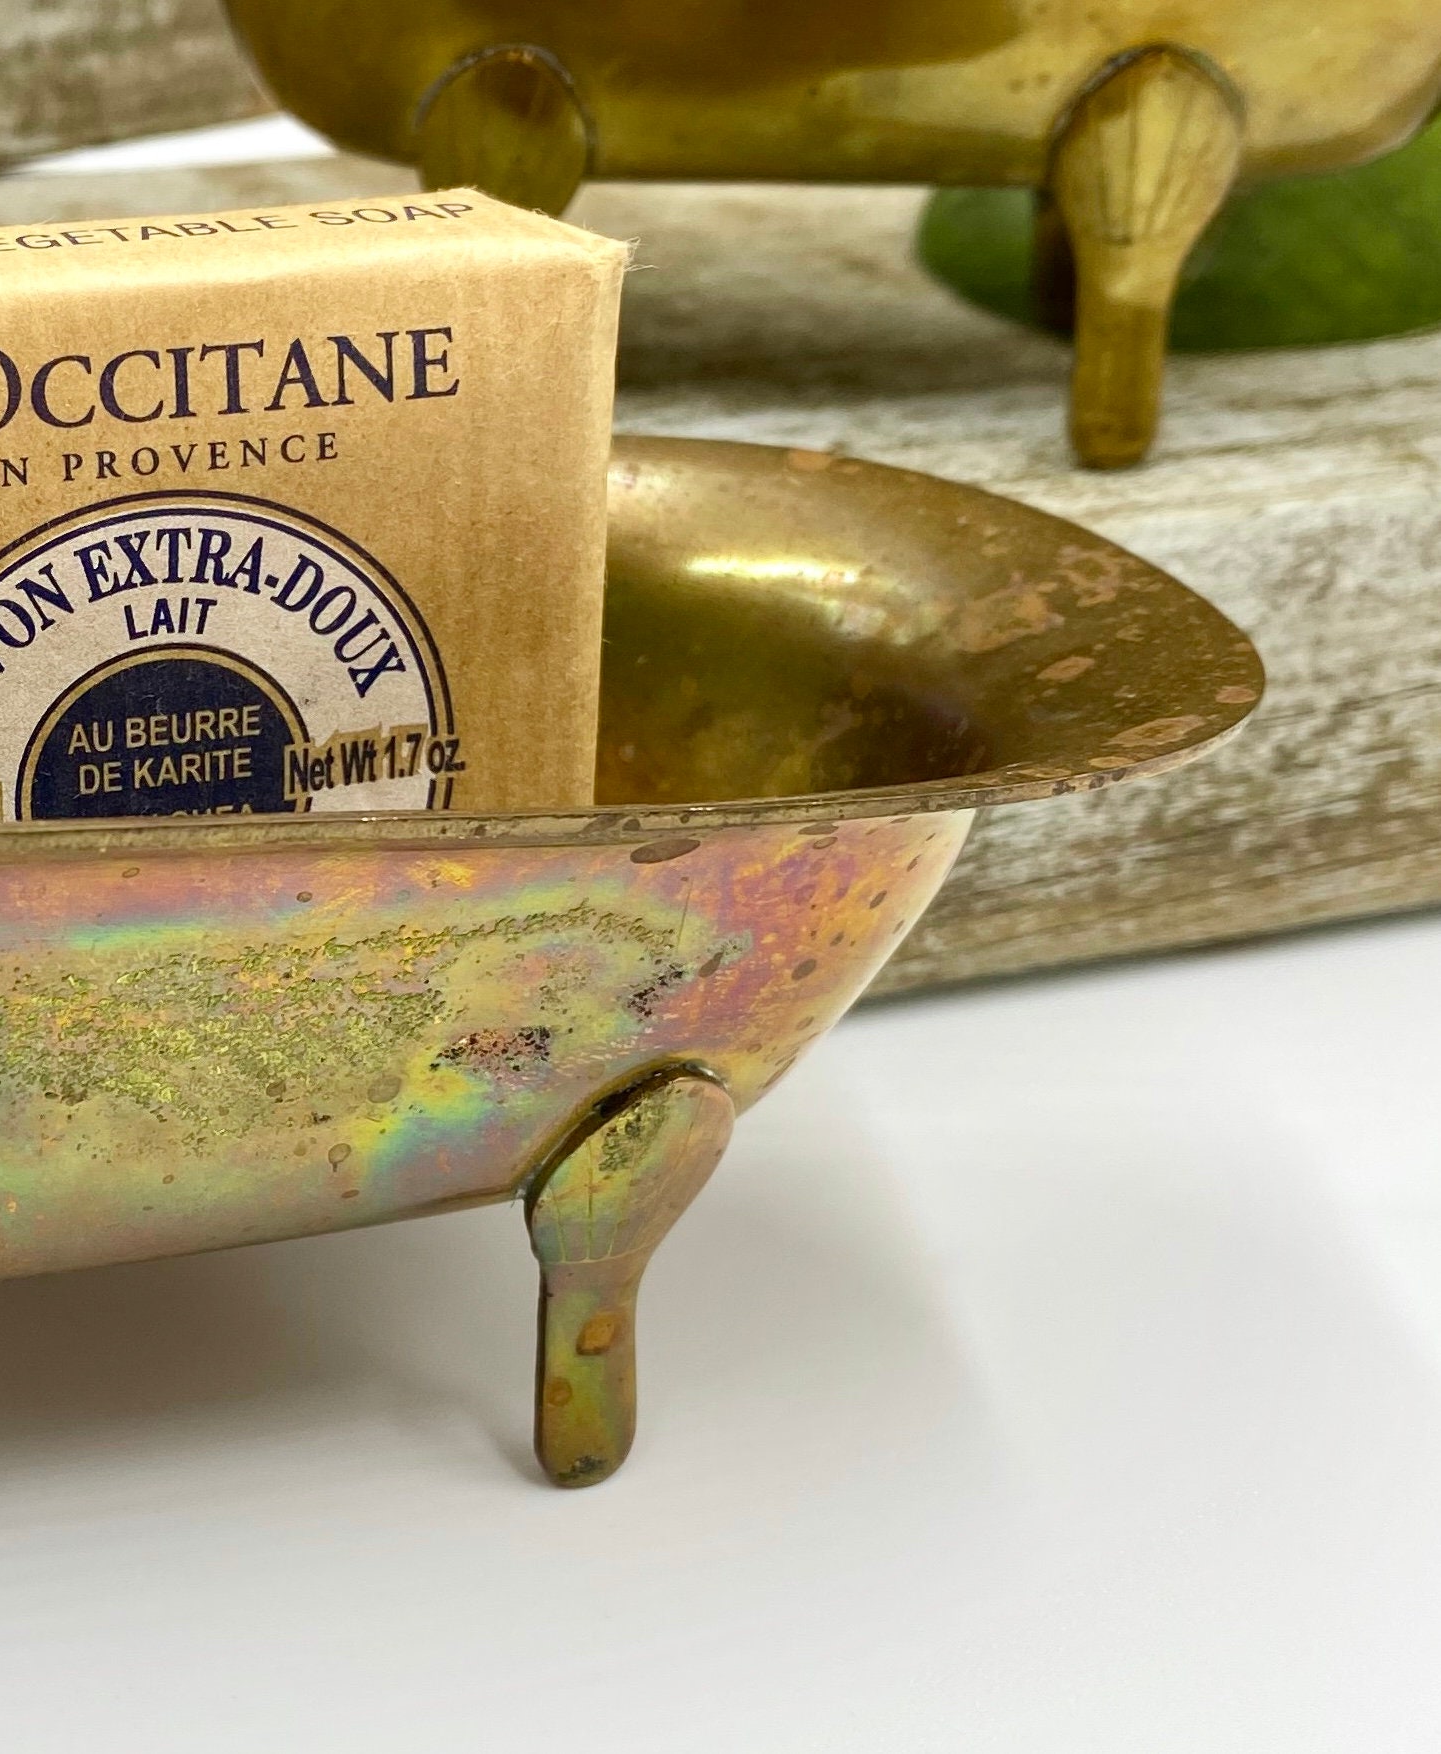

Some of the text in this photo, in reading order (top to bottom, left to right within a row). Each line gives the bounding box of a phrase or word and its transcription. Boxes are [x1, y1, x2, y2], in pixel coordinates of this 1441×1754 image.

[308, 202, 474, 227] SOAP
[62, 431, 340, 482] PROVENCE
[73, 527, 407, 698] EXTRA-DOUX
[122, 597, 218, 641] LAIT
[67, 704, 262, 756] AU BEURRE
[78, 747, 254, 795] DE KARITE
[289, 732, 466, 794] Net Wt 1.7 oz.
